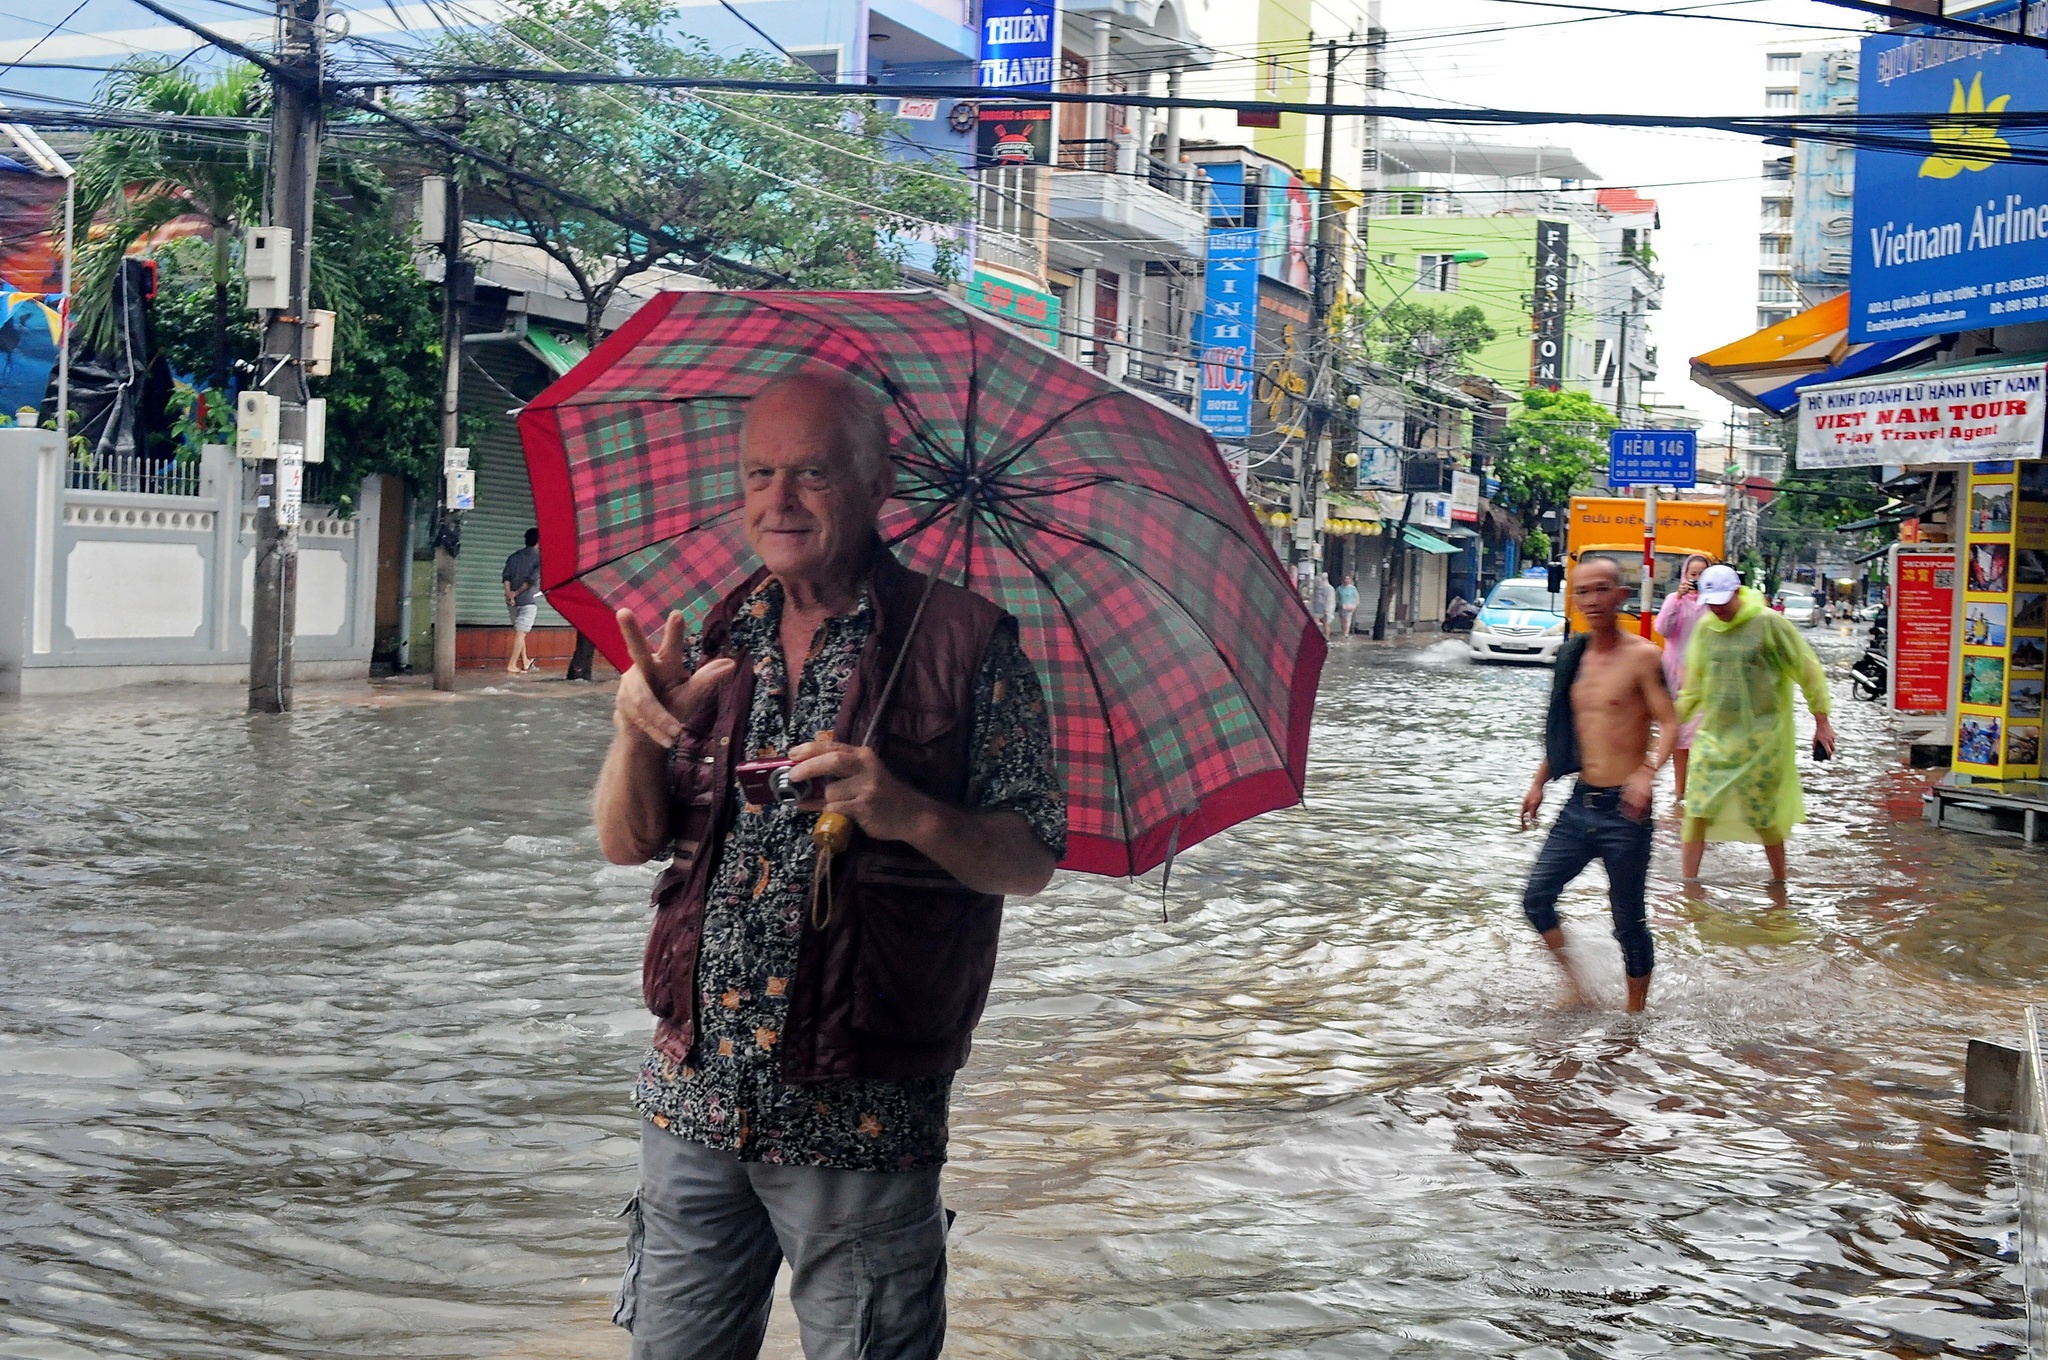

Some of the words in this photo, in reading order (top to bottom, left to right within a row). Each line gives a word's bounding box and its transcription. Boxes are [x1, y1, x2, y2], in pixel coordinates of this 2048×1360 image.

[985, 7, 1049, 45] THIÊN
[980, 57, 1051, 88] THANH
[1870, 221, 1962, 269] Vietnam
[1213, 257, 1246, 338] XINH
[1540, 230, 1560, 379] FASHION
[1206, 400, 1239, 411] HOTEL
[1827, 392, 1855, 409] KINH
[1859, 388, 1902, 405] DOANH
[1929, 379, 1965, 400] HÀNH
[1970, 377, 2002, 399] VIỆT
[2004, 376, 2040, 393] NAM
[1815, 411, 1867, 430] VIET
[1876, 405, 1940, 425] NAM
[1948, 399, 2027, 421] TOUR
[1622, 433, 1655, 456] HẺM
[1660, 440, 1685, 456] 146
[1834, 431, 1873, 445] T-jay
[1881, 426, 1944, 442] Travel
[1950, 424, 1998, 442] Agent
[1583, 514, 1611, 524] BƯU
[1682, 519, 1713, 528] NAM
